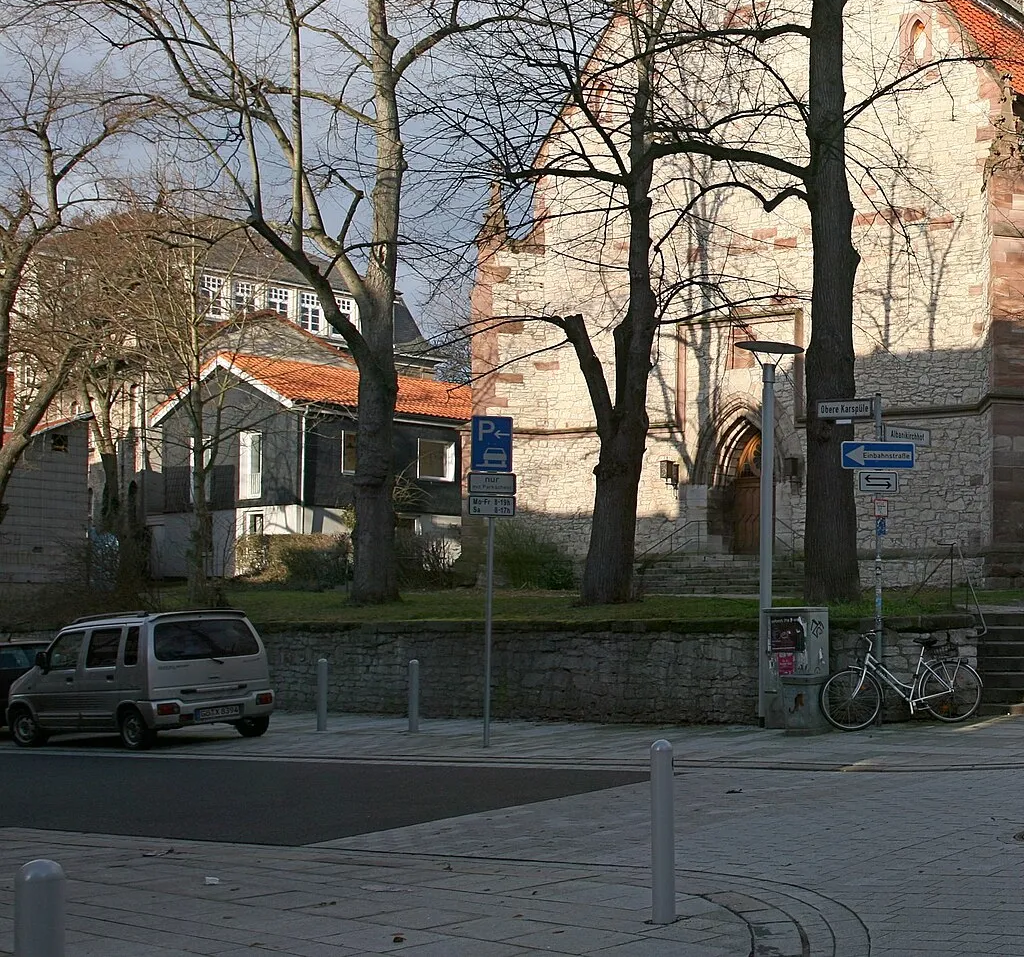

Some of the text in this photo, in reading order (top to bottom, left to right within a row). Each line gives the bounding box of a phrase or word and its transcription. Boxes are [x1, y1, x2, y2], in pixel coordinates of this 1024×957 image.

[820, 403, 869, 415] Obere Karspüle
[478, 420, 495, 442] P
[890, 429, 925, 441] Albanikirchhof
